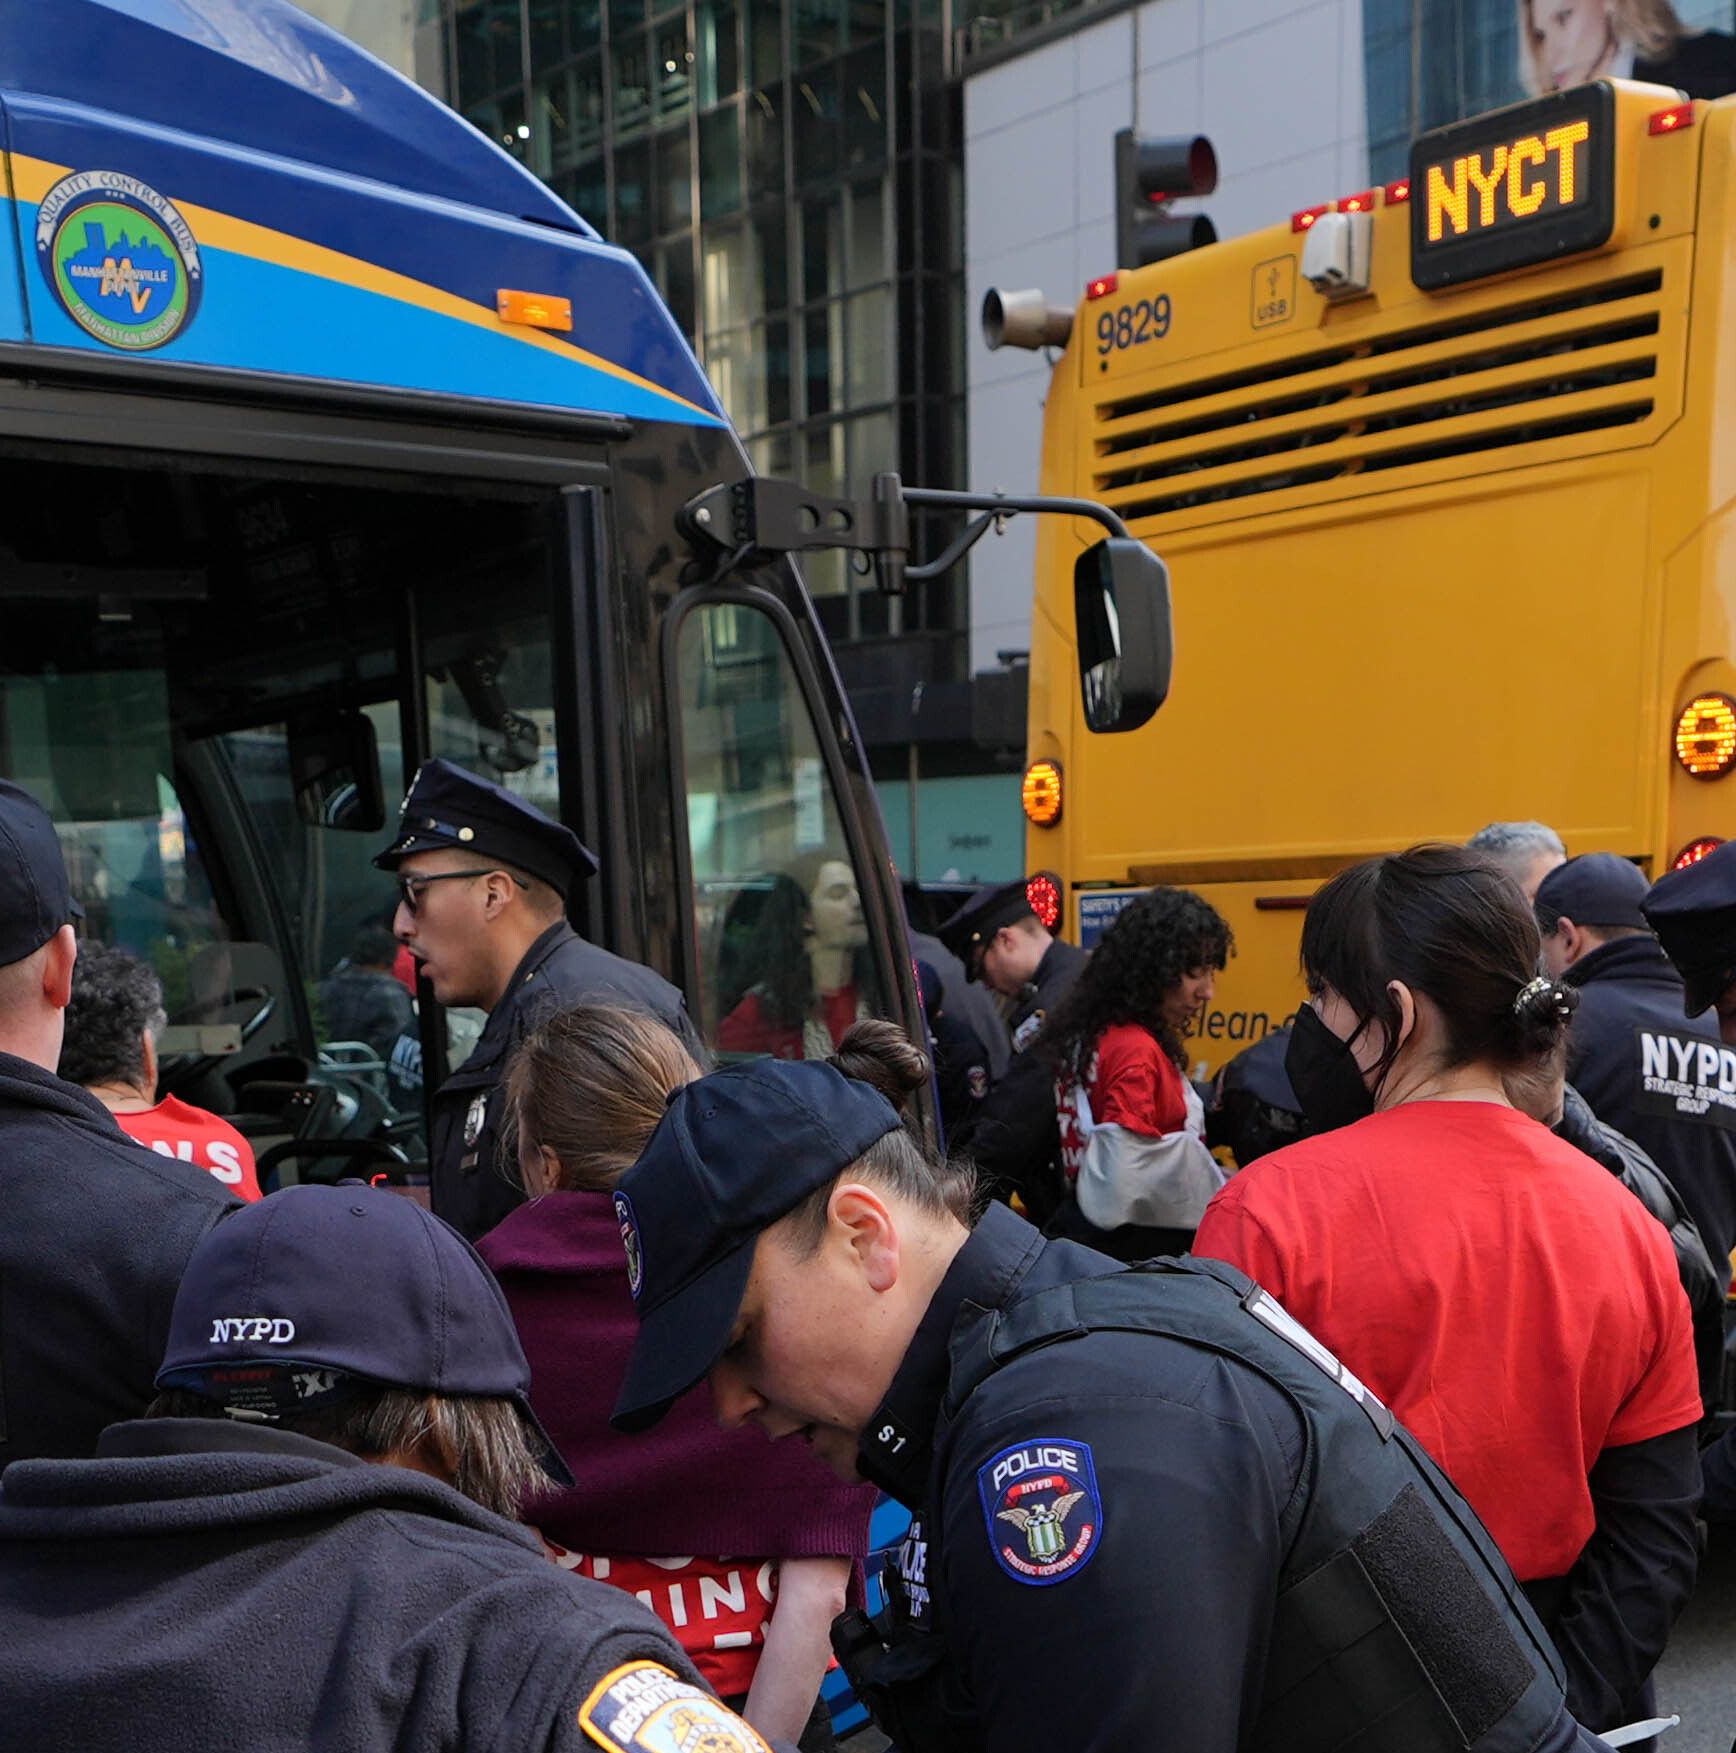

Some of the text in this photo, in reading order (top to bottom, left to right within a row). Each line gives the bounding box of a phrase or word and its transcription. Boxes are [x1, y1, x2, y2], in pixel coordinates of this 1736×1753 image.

[1427, 120, 1590, 242] NYCT
[40, 173, 193, 253] QUALITY CONTROL BUS
[1257, 299, 1287, 321] USB
[1097, 293, 1171, 355] 9829
[1644, 1076, 1694, 1098] STRATEGIC
[1676, 1096, 1710, 1115] GROUP
[209, 1317, 296, 1344] NYPD
[993, 1447, 1079, 1491] POLICE
[1021, 1477, 1054, 1495] NYPD
